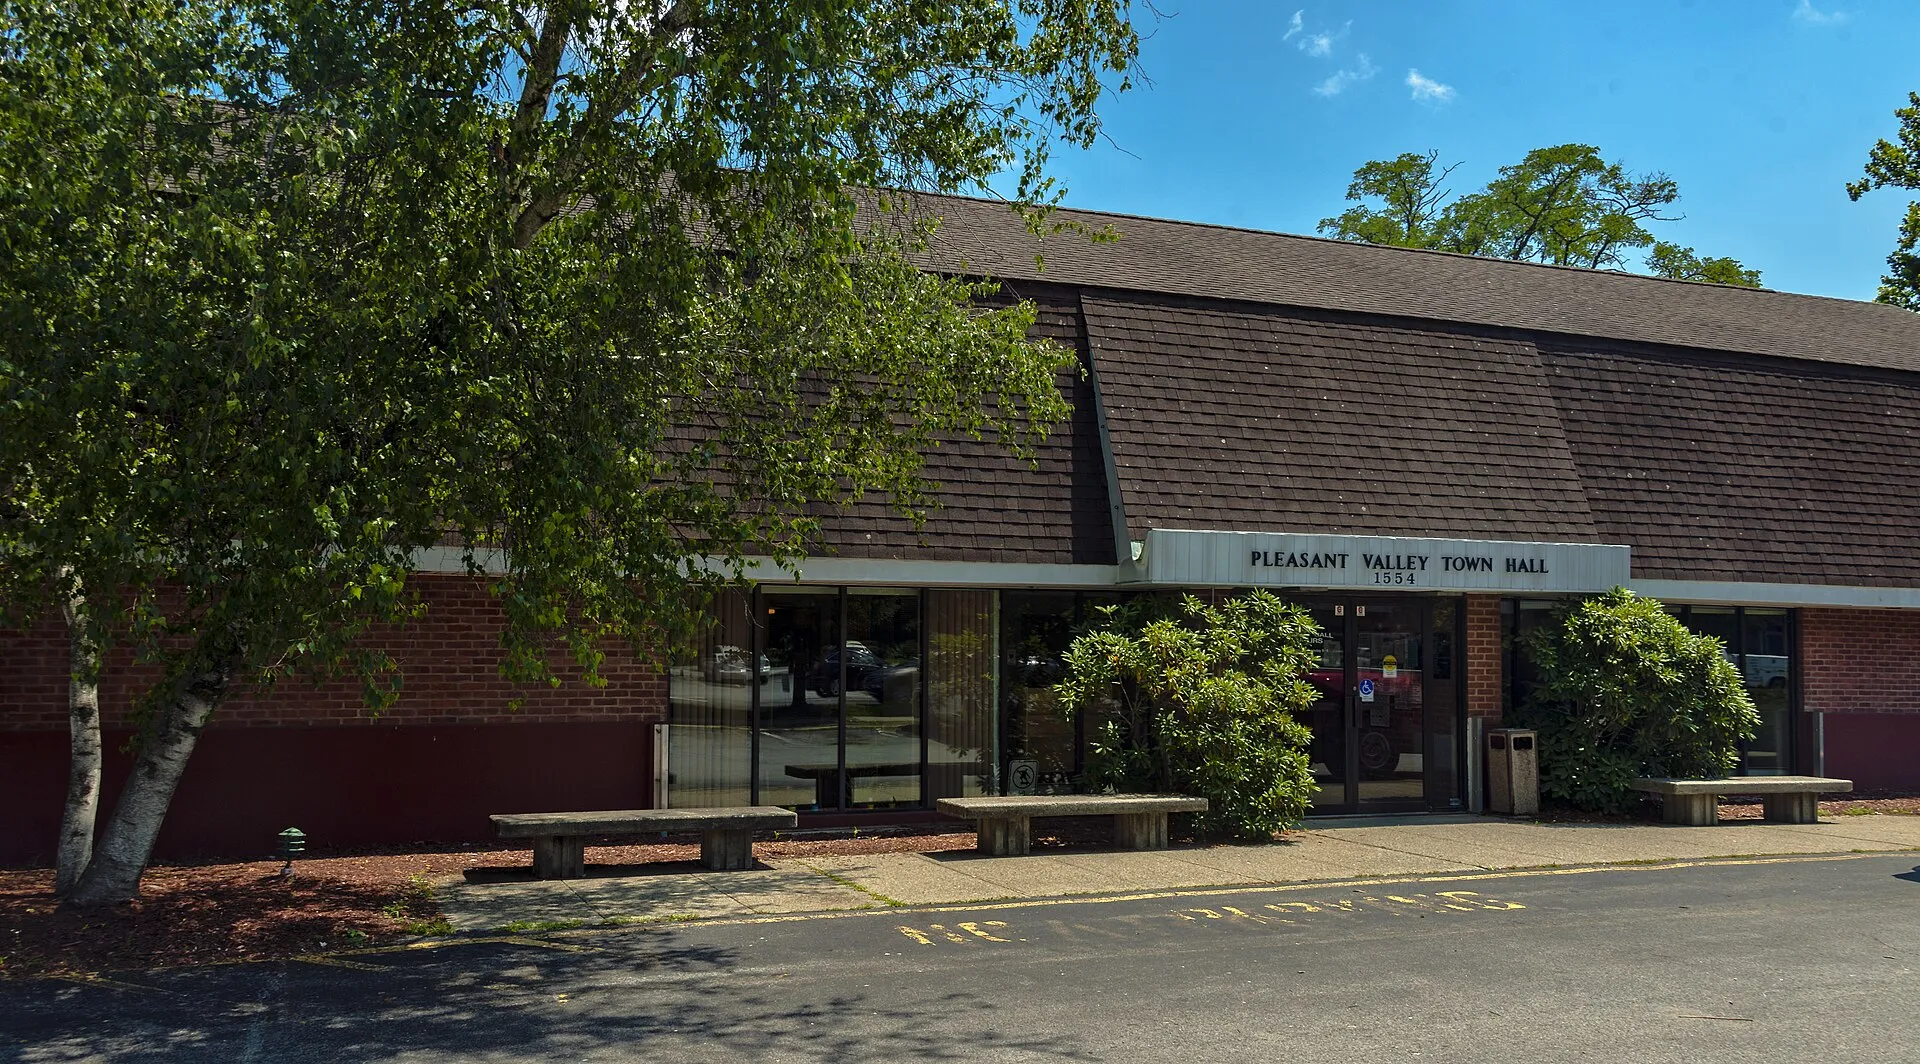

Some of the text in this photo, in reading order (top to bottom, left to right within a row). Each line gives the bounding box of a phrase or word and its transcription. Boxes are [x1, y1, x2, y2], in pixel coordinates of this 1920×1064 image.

[1251, 551, 1549, 574] PLEASANT VALLEY TOWN HALL
[1374, 571, 1416, 585] 1554
